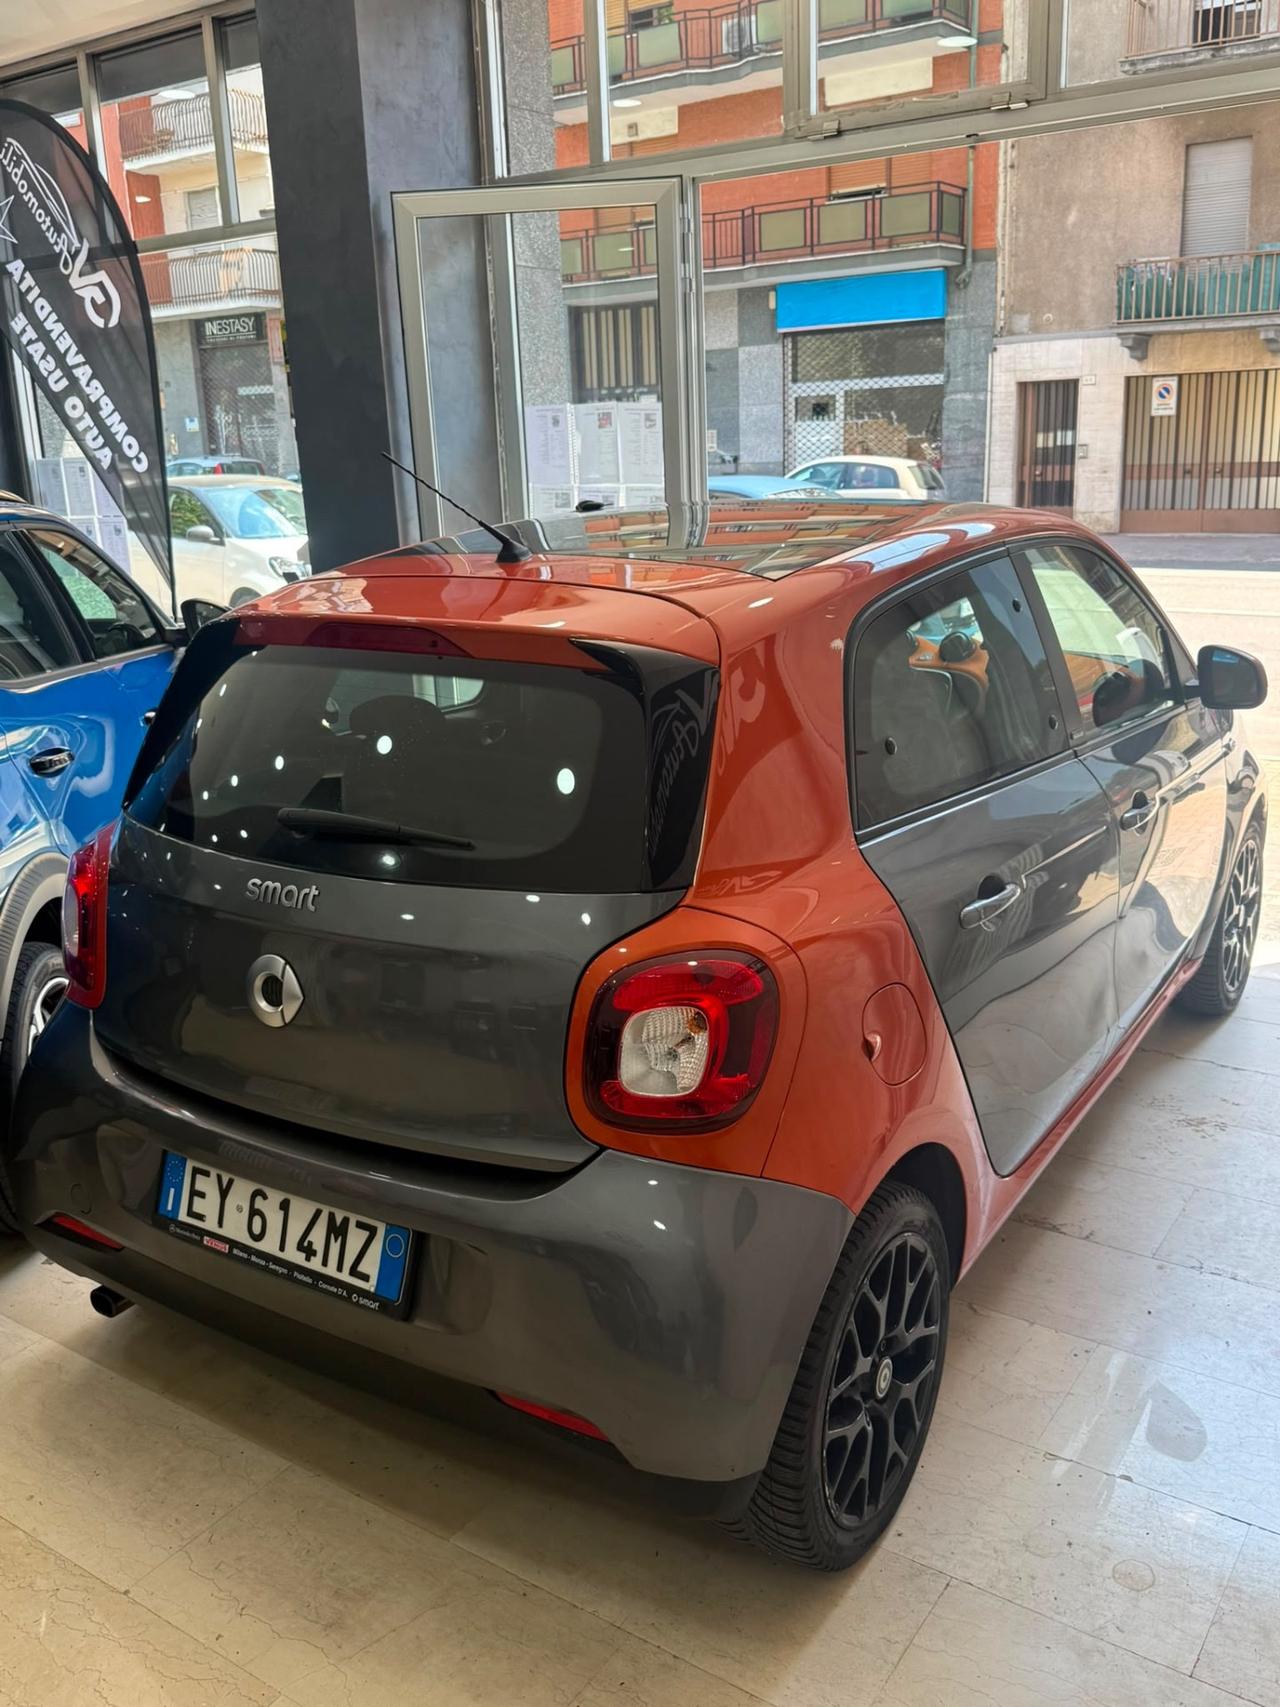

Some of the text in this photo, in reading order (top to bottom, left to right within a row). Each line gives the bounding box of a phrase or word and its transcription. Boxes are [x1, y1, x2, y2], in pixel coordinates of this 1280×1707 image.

[205, 316, 255, 336] INESTASY
[246, 878, 319, 912] smart
[359, 1296, 380, 1310] smart
